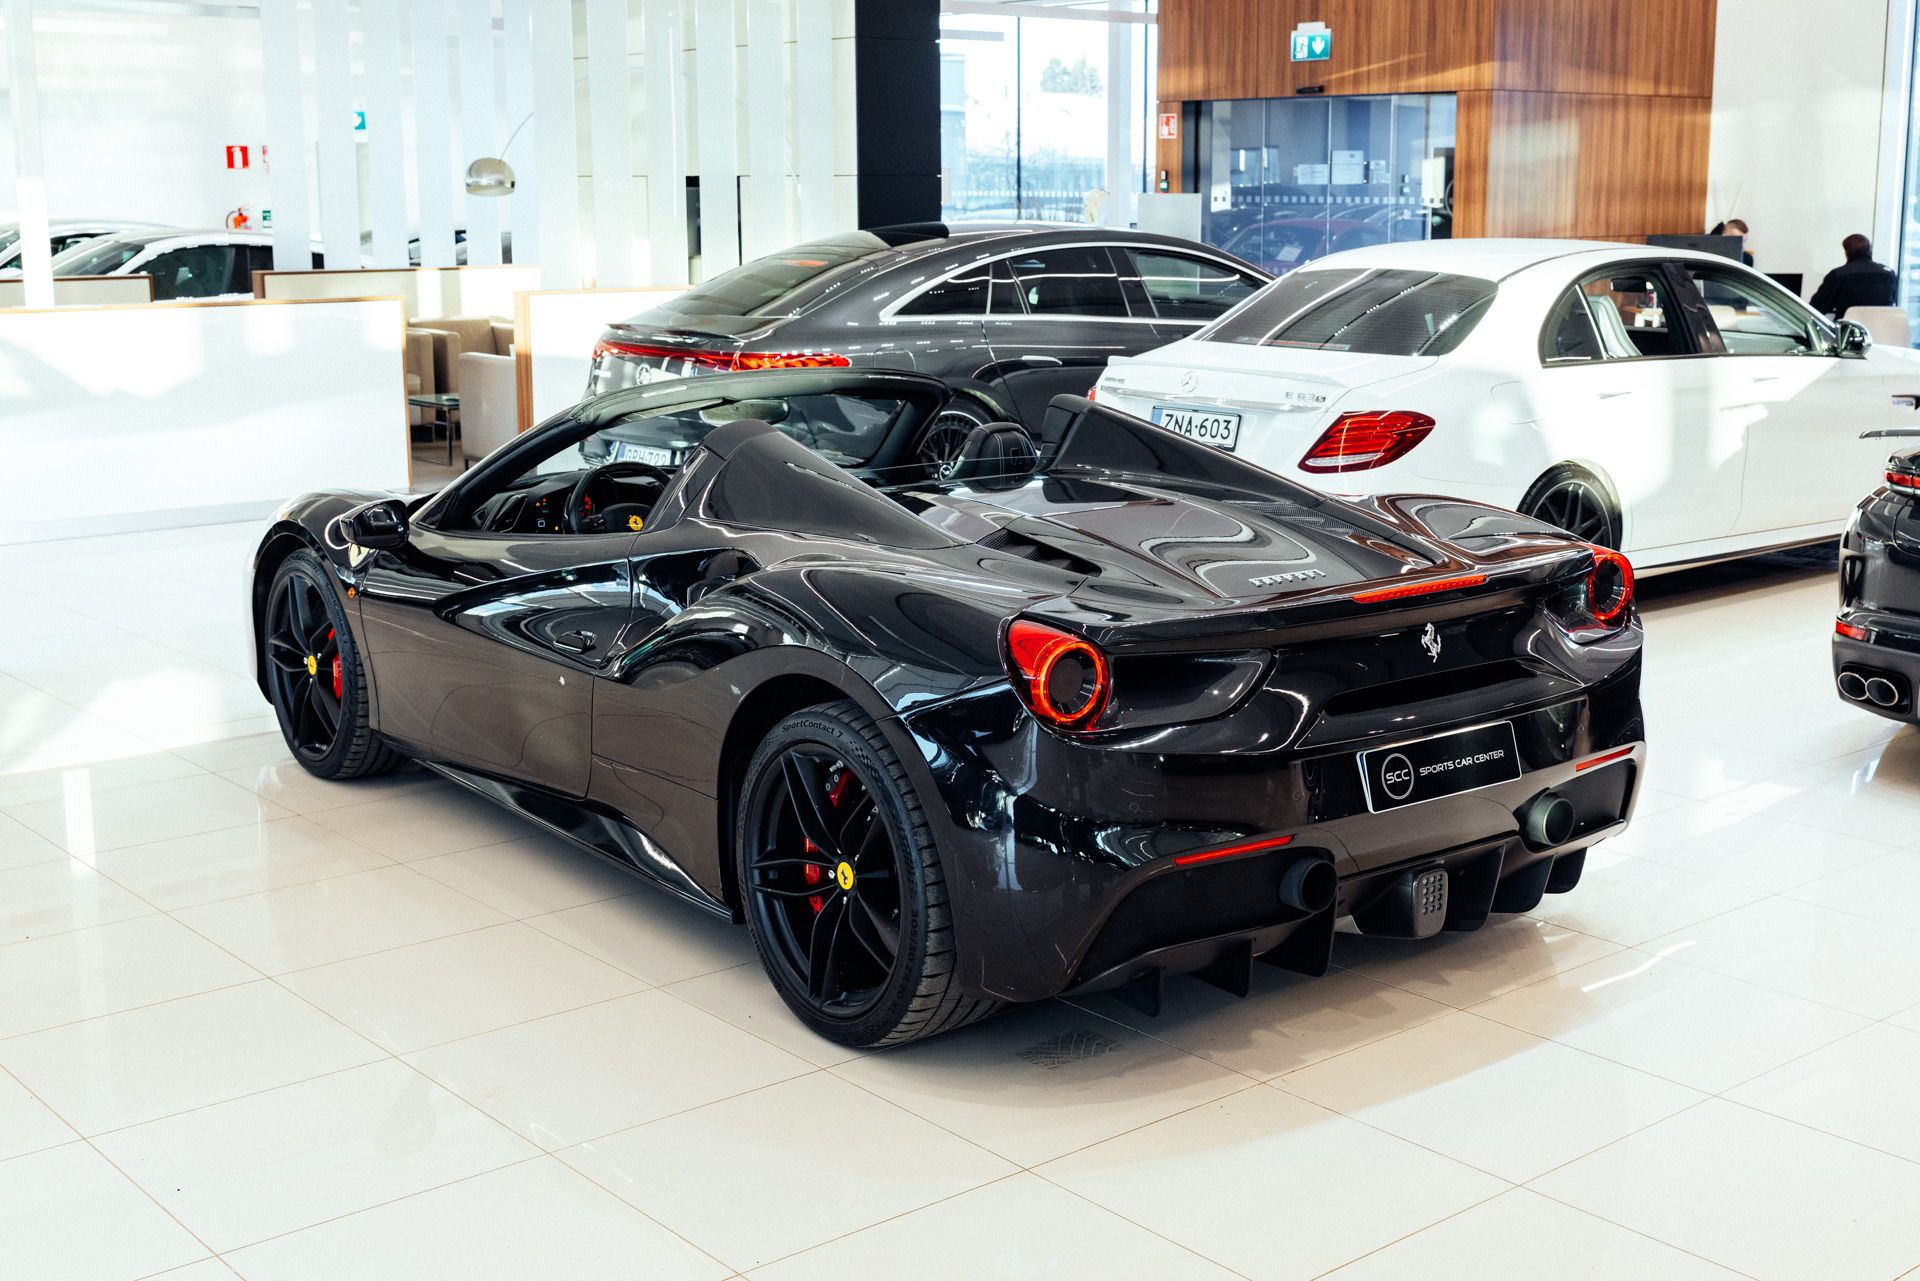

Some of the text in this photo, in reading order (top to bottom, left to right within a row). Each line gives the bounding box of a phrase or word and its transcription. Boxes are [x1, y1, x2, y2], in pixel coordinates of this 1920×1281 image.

[1248, 569, 1327, 588] FERRARI
[782, 719, 844, 738] SportContact 7
[1420, 749, 1505, 776] SPORTS CAR CENTER
[1386, 769, 1410, 784] SCC
[908, 910, 919, 962] 305/30
